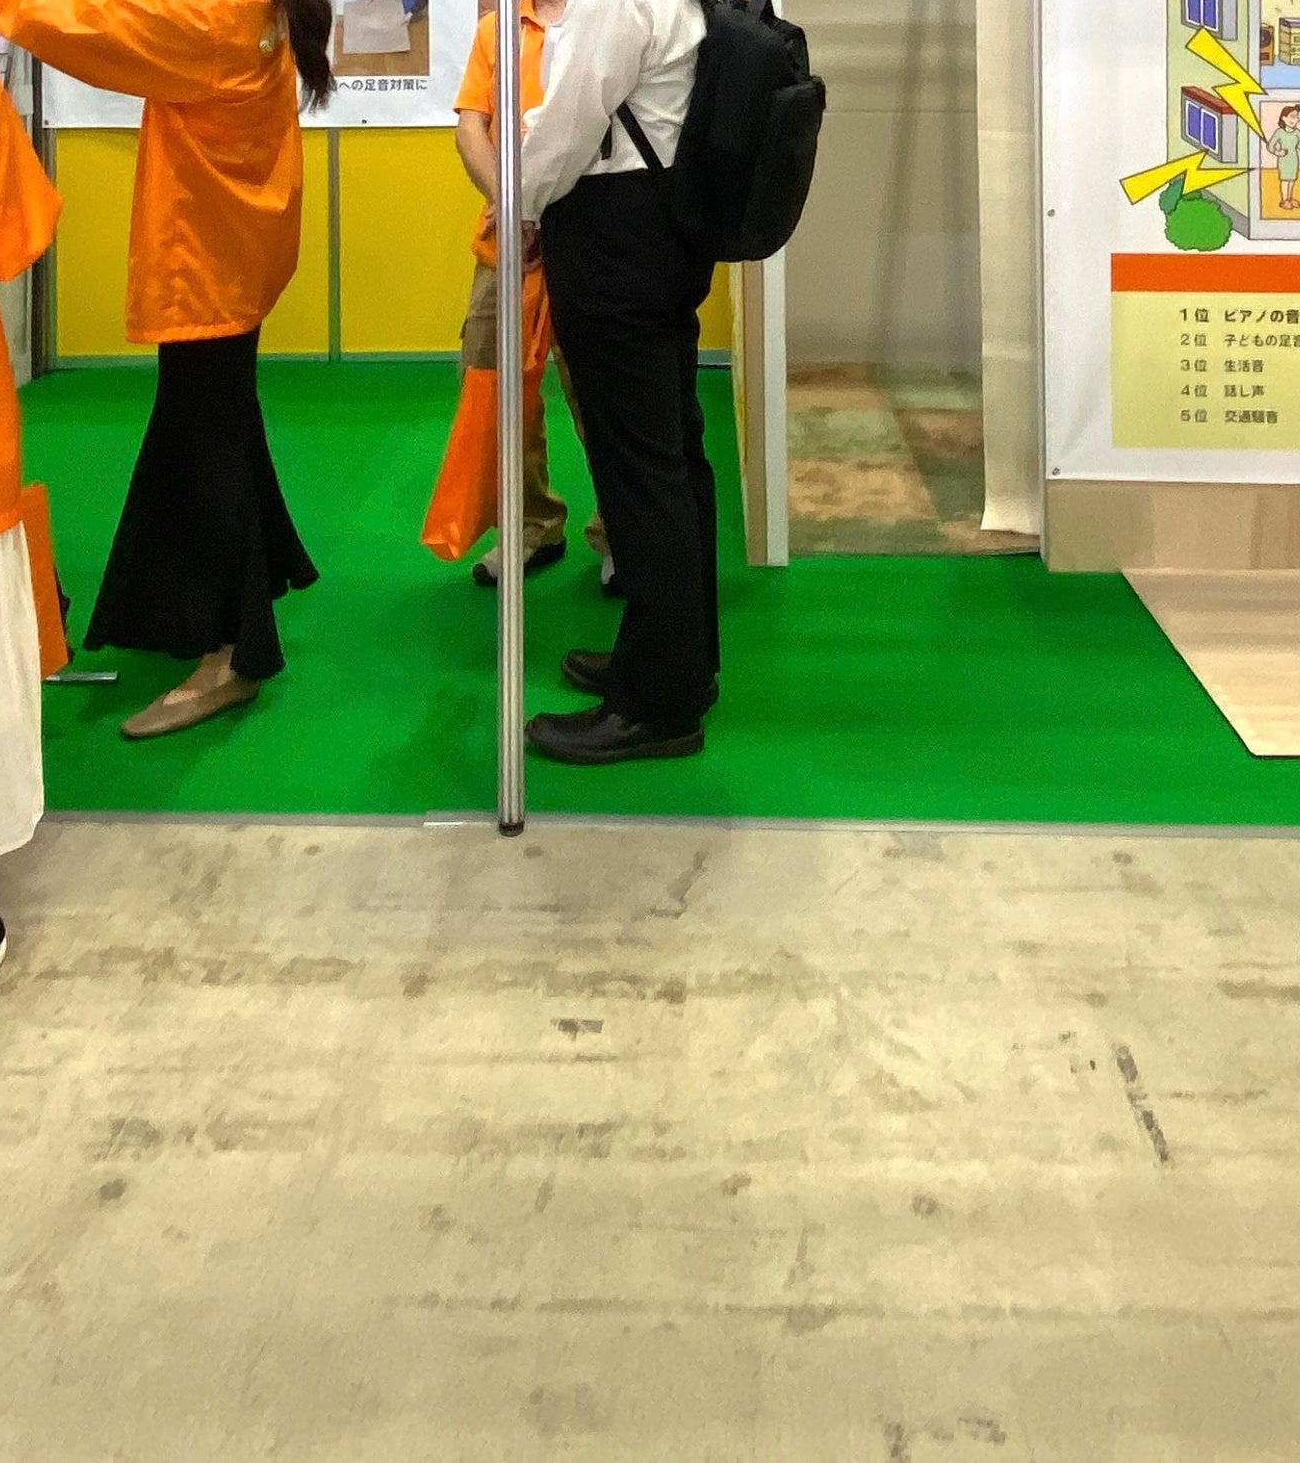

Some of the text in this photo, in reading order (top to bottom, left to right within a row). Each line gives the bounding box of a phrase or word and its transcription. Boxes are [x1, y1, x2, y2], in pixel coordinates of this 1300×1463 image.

[1224, 309, 1300, 324] ピアノの音
